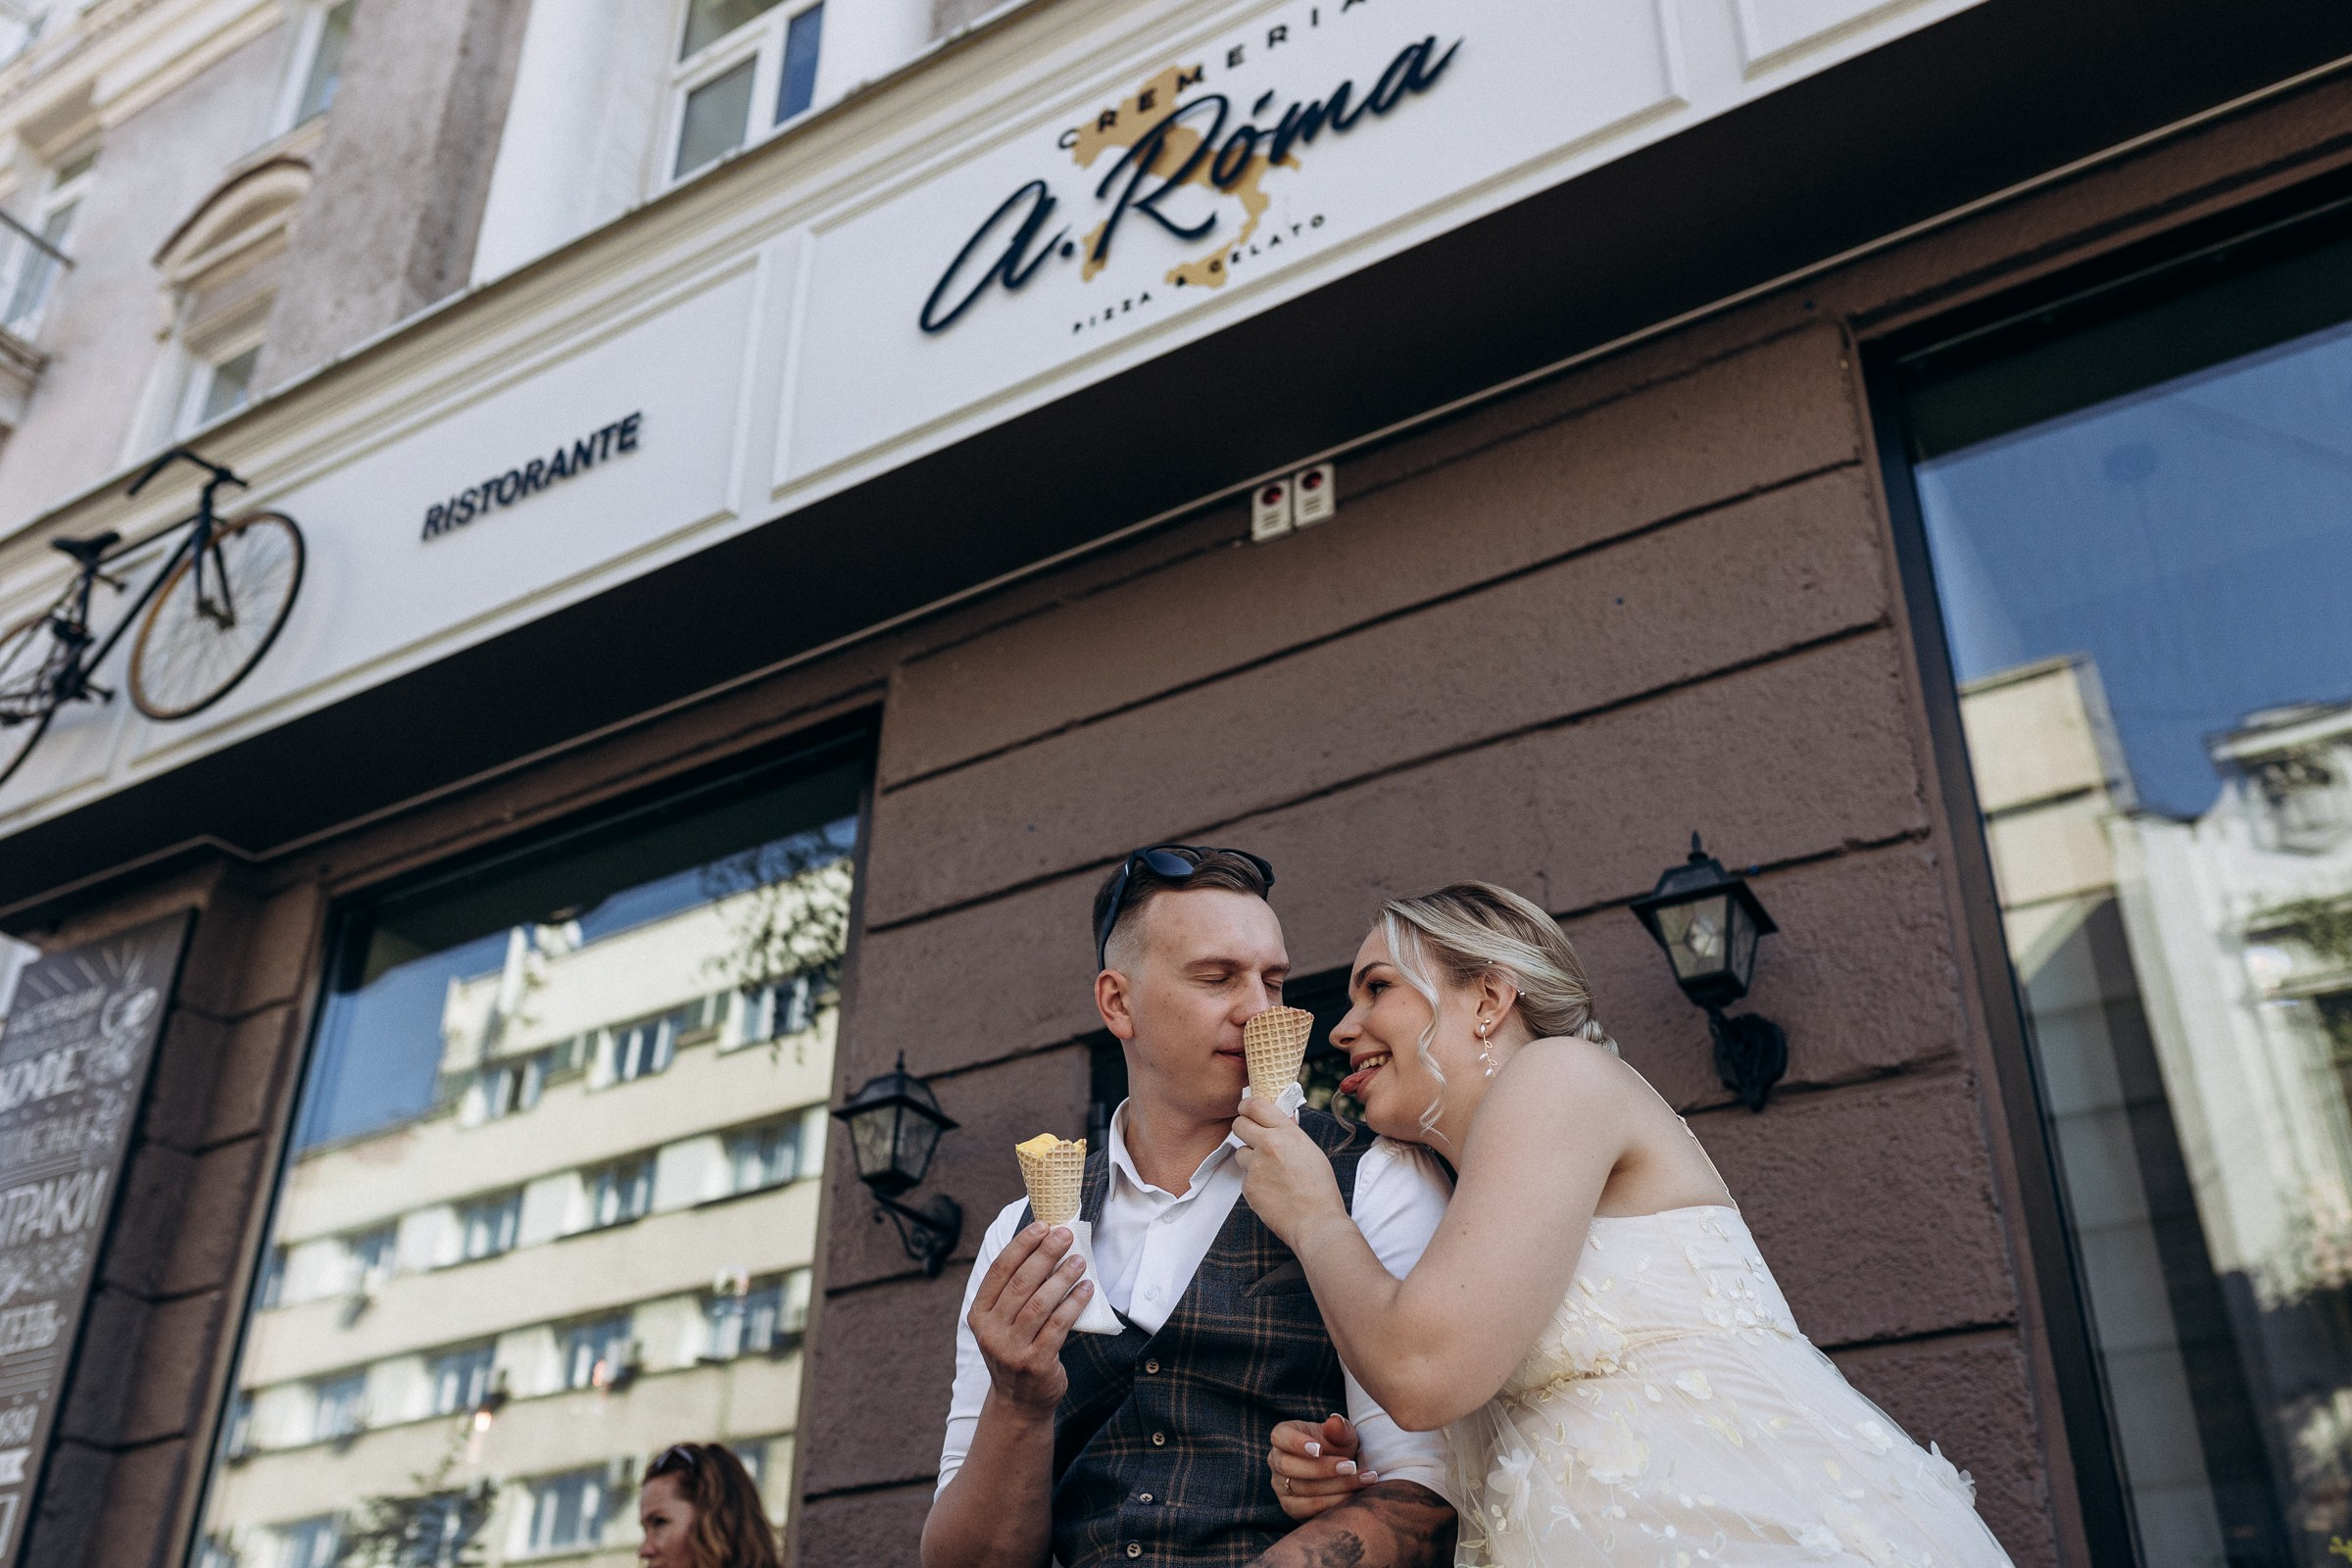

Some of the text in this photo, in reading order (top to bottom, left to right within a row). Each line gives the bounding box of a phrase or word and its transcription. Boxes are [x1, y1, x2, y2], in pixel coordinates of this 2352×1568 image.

[1073, 292, 1152, 334] PIZZA
[1207, 214, 1325, 273] GELATO
[421, 411, 641, 541] RISTORANTE
